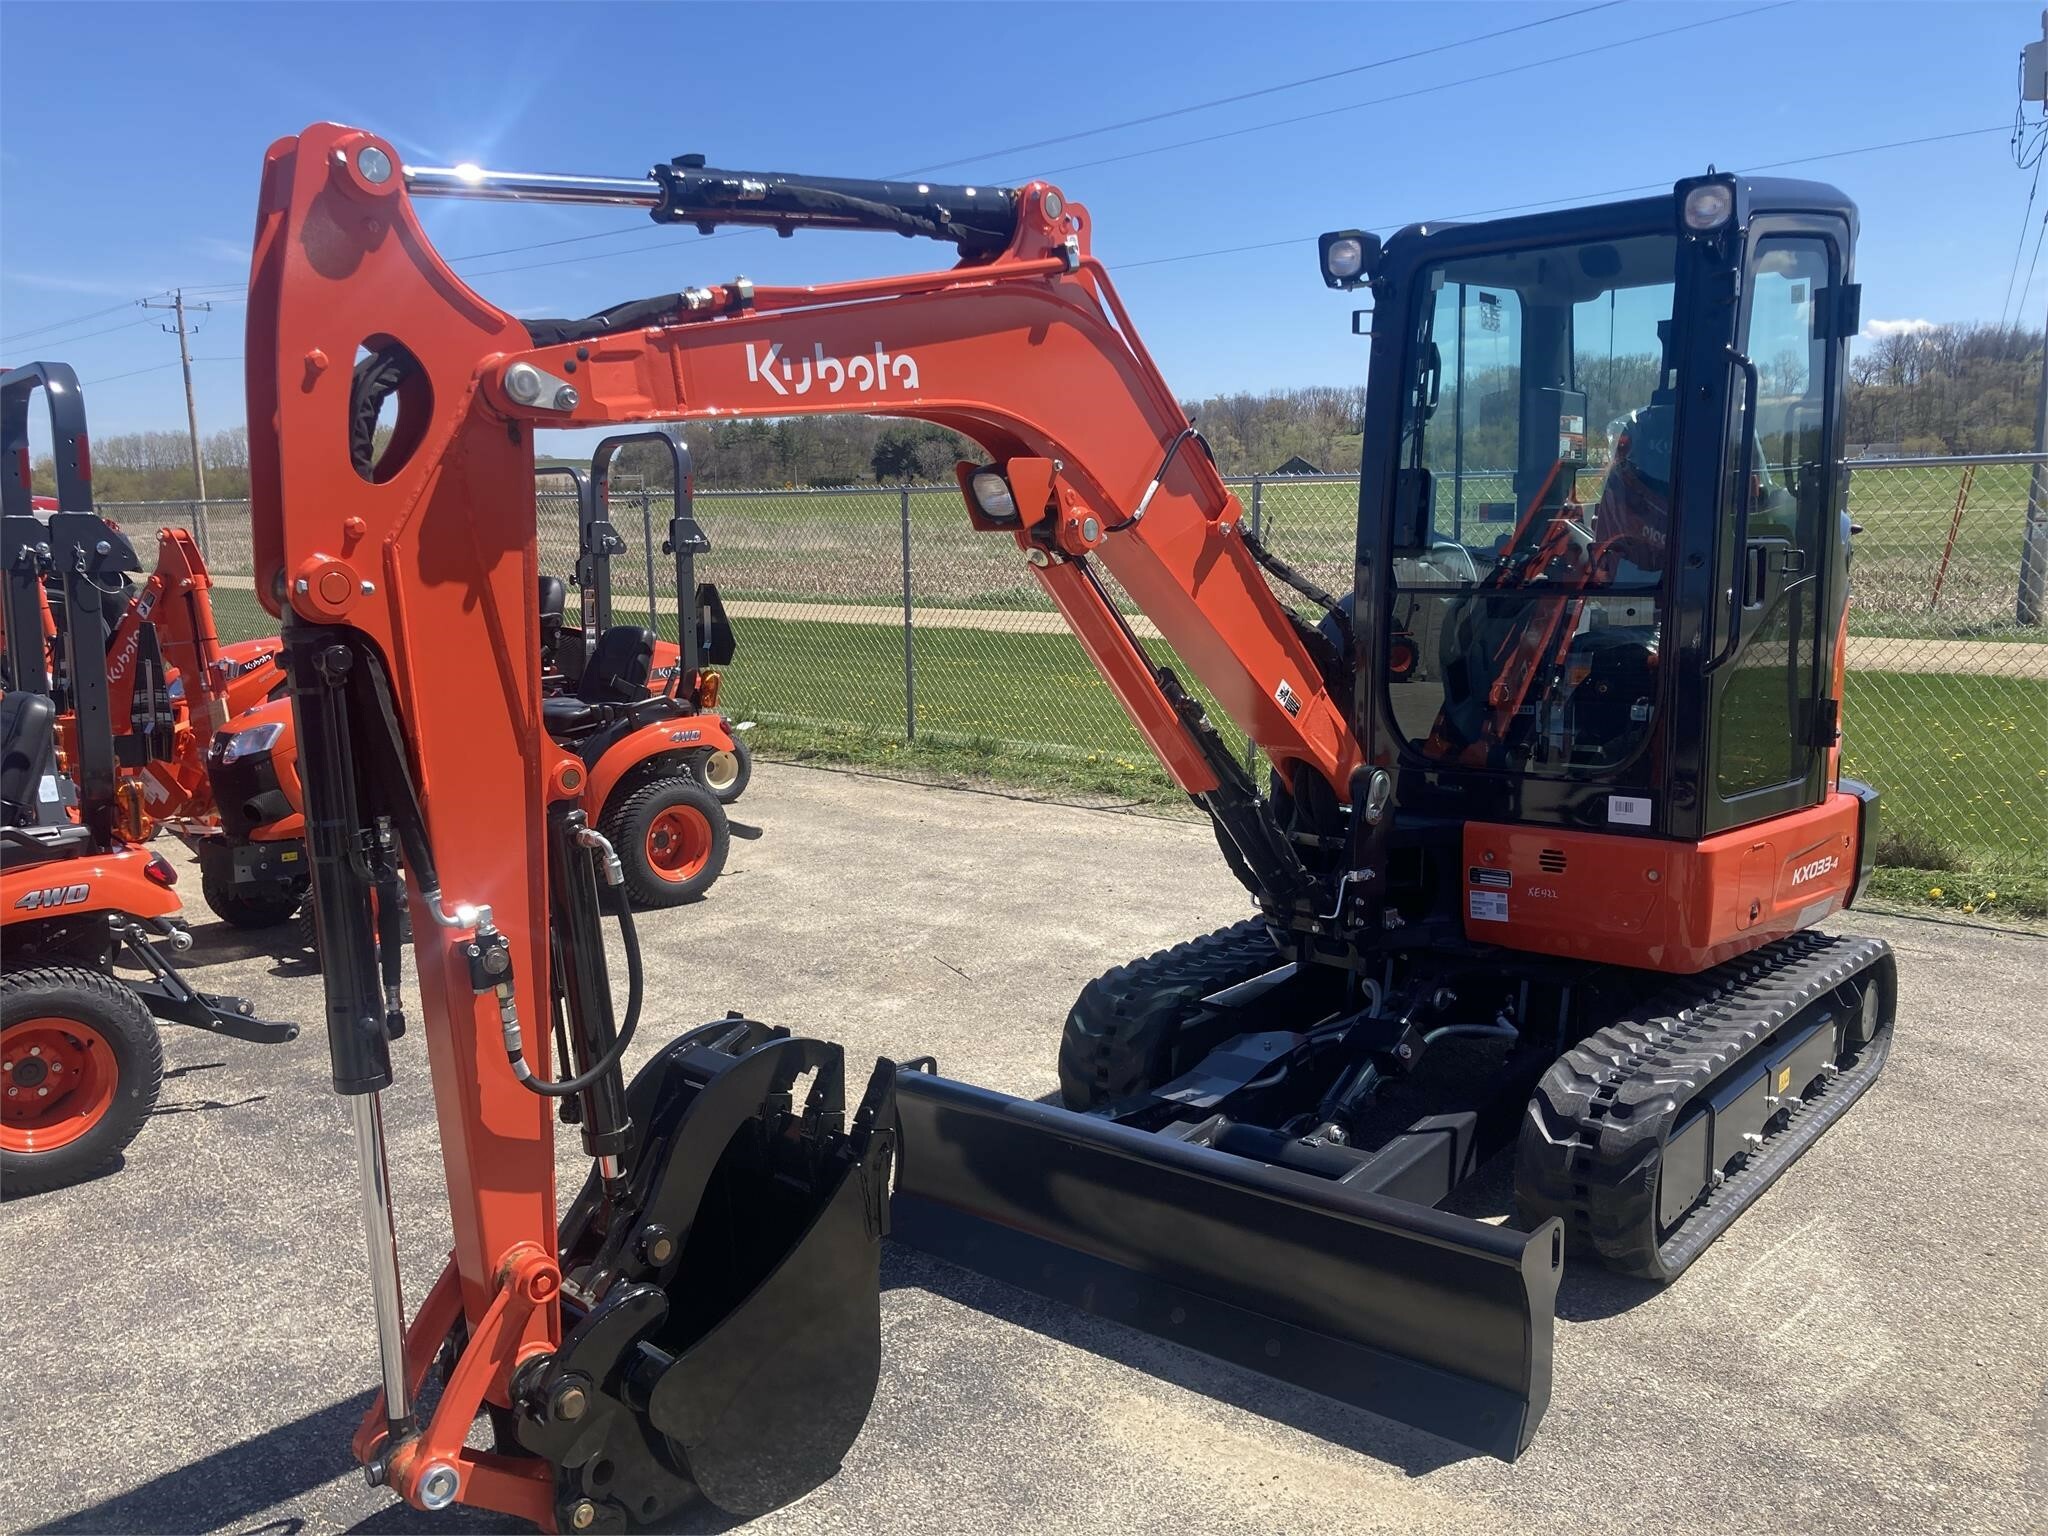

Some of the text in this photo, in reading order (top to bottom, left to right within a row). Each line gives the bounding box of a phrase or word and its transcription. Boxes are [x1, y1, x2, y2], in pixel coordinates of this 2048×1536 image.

[745, 341, 920, 395] Kubota
[244, 654, 272, 670] Kubota
[669, 730, 701, 742] 4WD
[1791, 856, 1839, 886] KX033-4
[14, 883, 90, 911] 4WD
